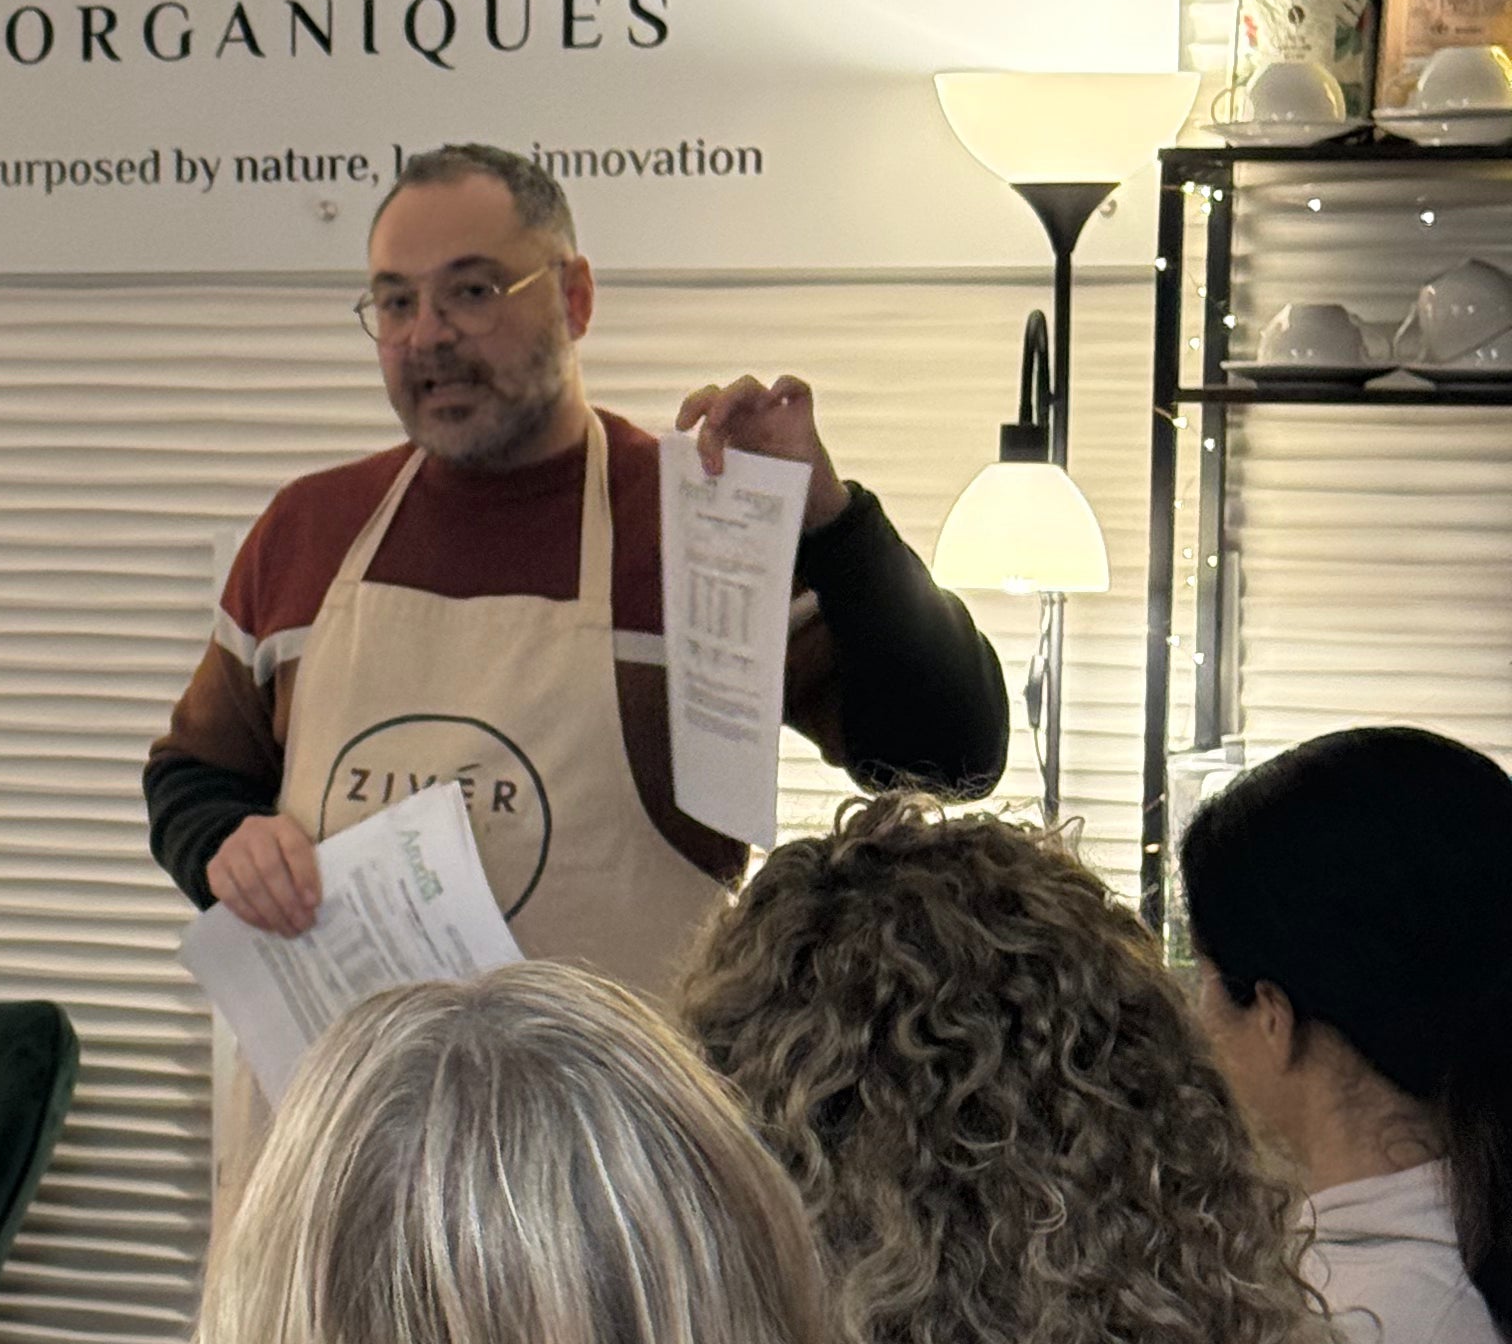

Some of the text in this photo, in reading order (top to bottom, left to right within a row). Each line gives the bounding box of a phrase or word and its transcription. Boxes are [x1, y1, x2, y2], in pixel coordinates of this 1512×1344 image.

[174, 147, 220, 193] by
[234, 147, 380, 188] nature,
[531, 140, 763, 180] innovation
